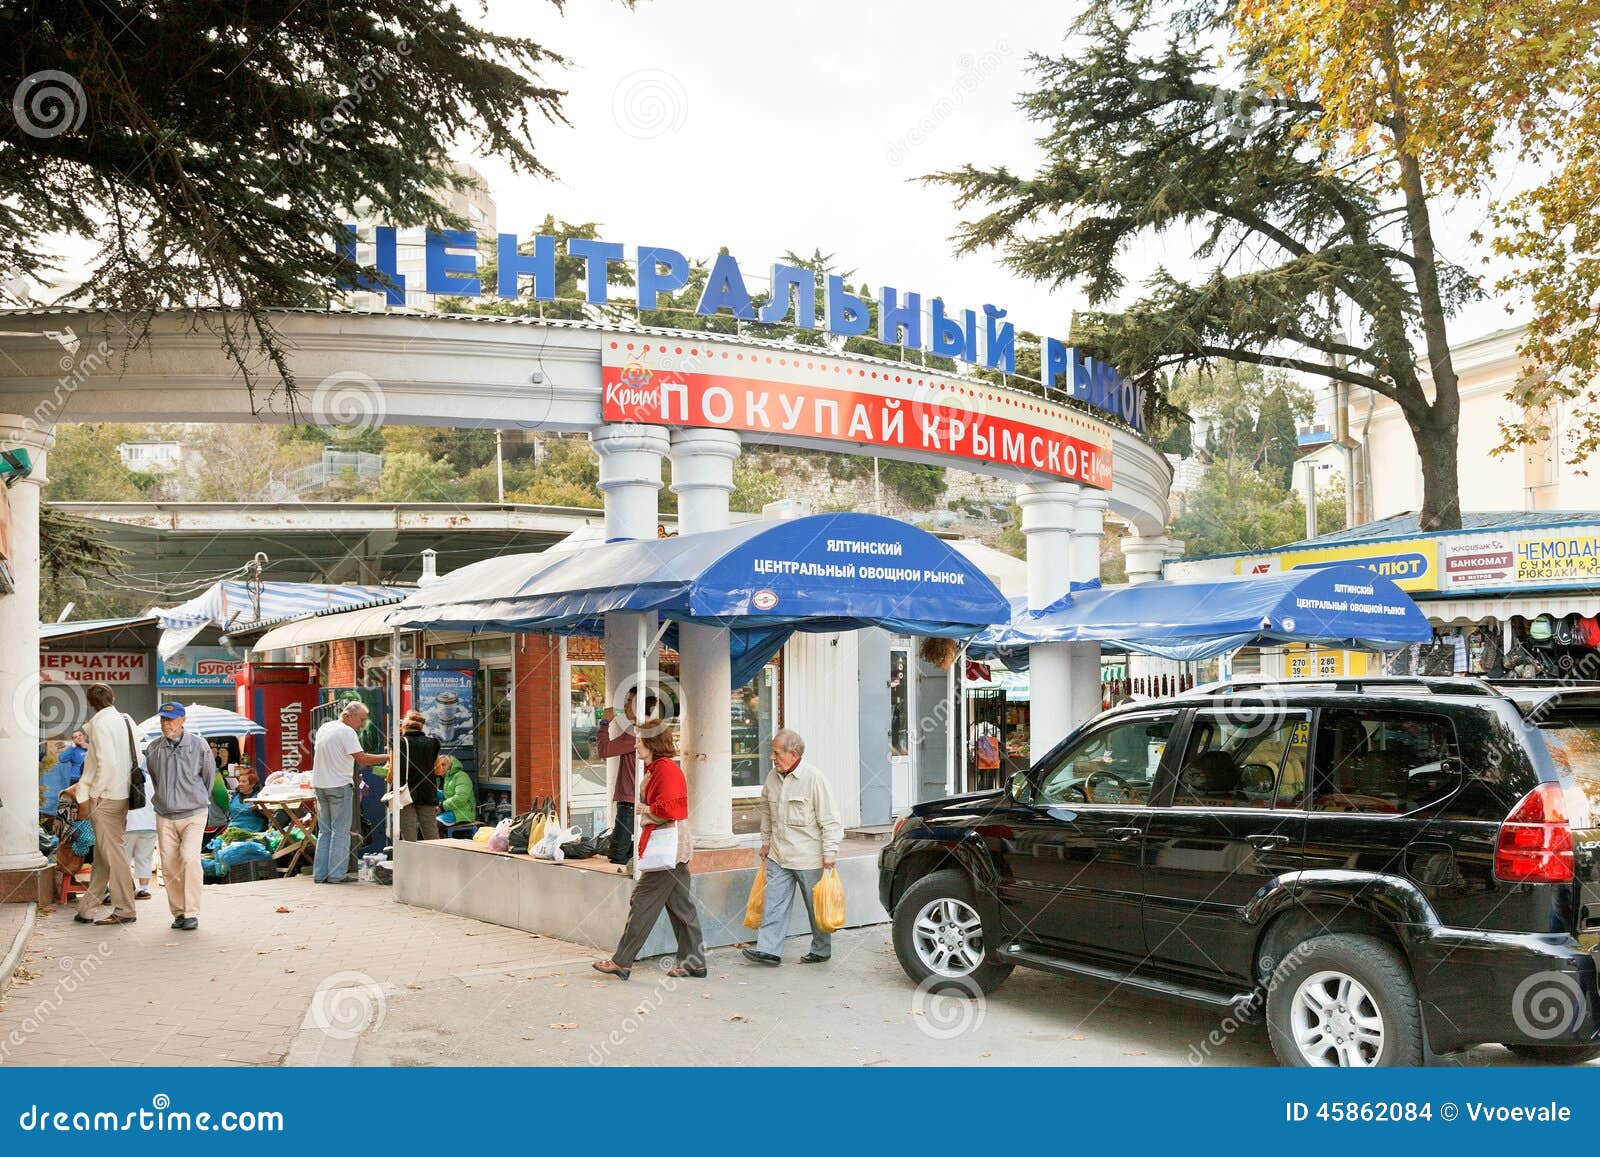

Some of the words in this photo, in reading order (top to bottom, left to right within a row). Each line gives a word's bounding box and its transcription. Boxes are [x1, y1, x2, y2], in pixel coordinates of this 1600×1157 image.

[336, 224, 1015, 374] ЦЕНТРАЛЬНЫЙ
[1041, 336, 1147, 432] РЫНОК
[605, 381, 658, 415] Крым
[660, 383, 904, 445] ПОКУПАЙ
[921, 413, 1097, 482] КРЫМСКОЕ!
[826, 539, 902, 556] ЯЛТИНСКИЙ
[1450, 556, 1508, 568] БАНКОМАТ
[1521, 558, 1573, 570] СУМКИ
[754, 559, 856, 578] ЦЕНТРАЛЬНЫЙ
[923, 570, 964, 585] РЫНОК
[1518, 567, 1577, 579] РЮКЗАКИ
[1334, 583, 1373, 596] ЯЛТИНСКИЙ
[1296, 598, 1348, 612] ЦЕНТРАЛЬНЫЙ
[1383, 606, 1406, 616] РЫНОК
[65, 671, 130, 681] шапки
[160, 676, 220, 685] Алуштинский
